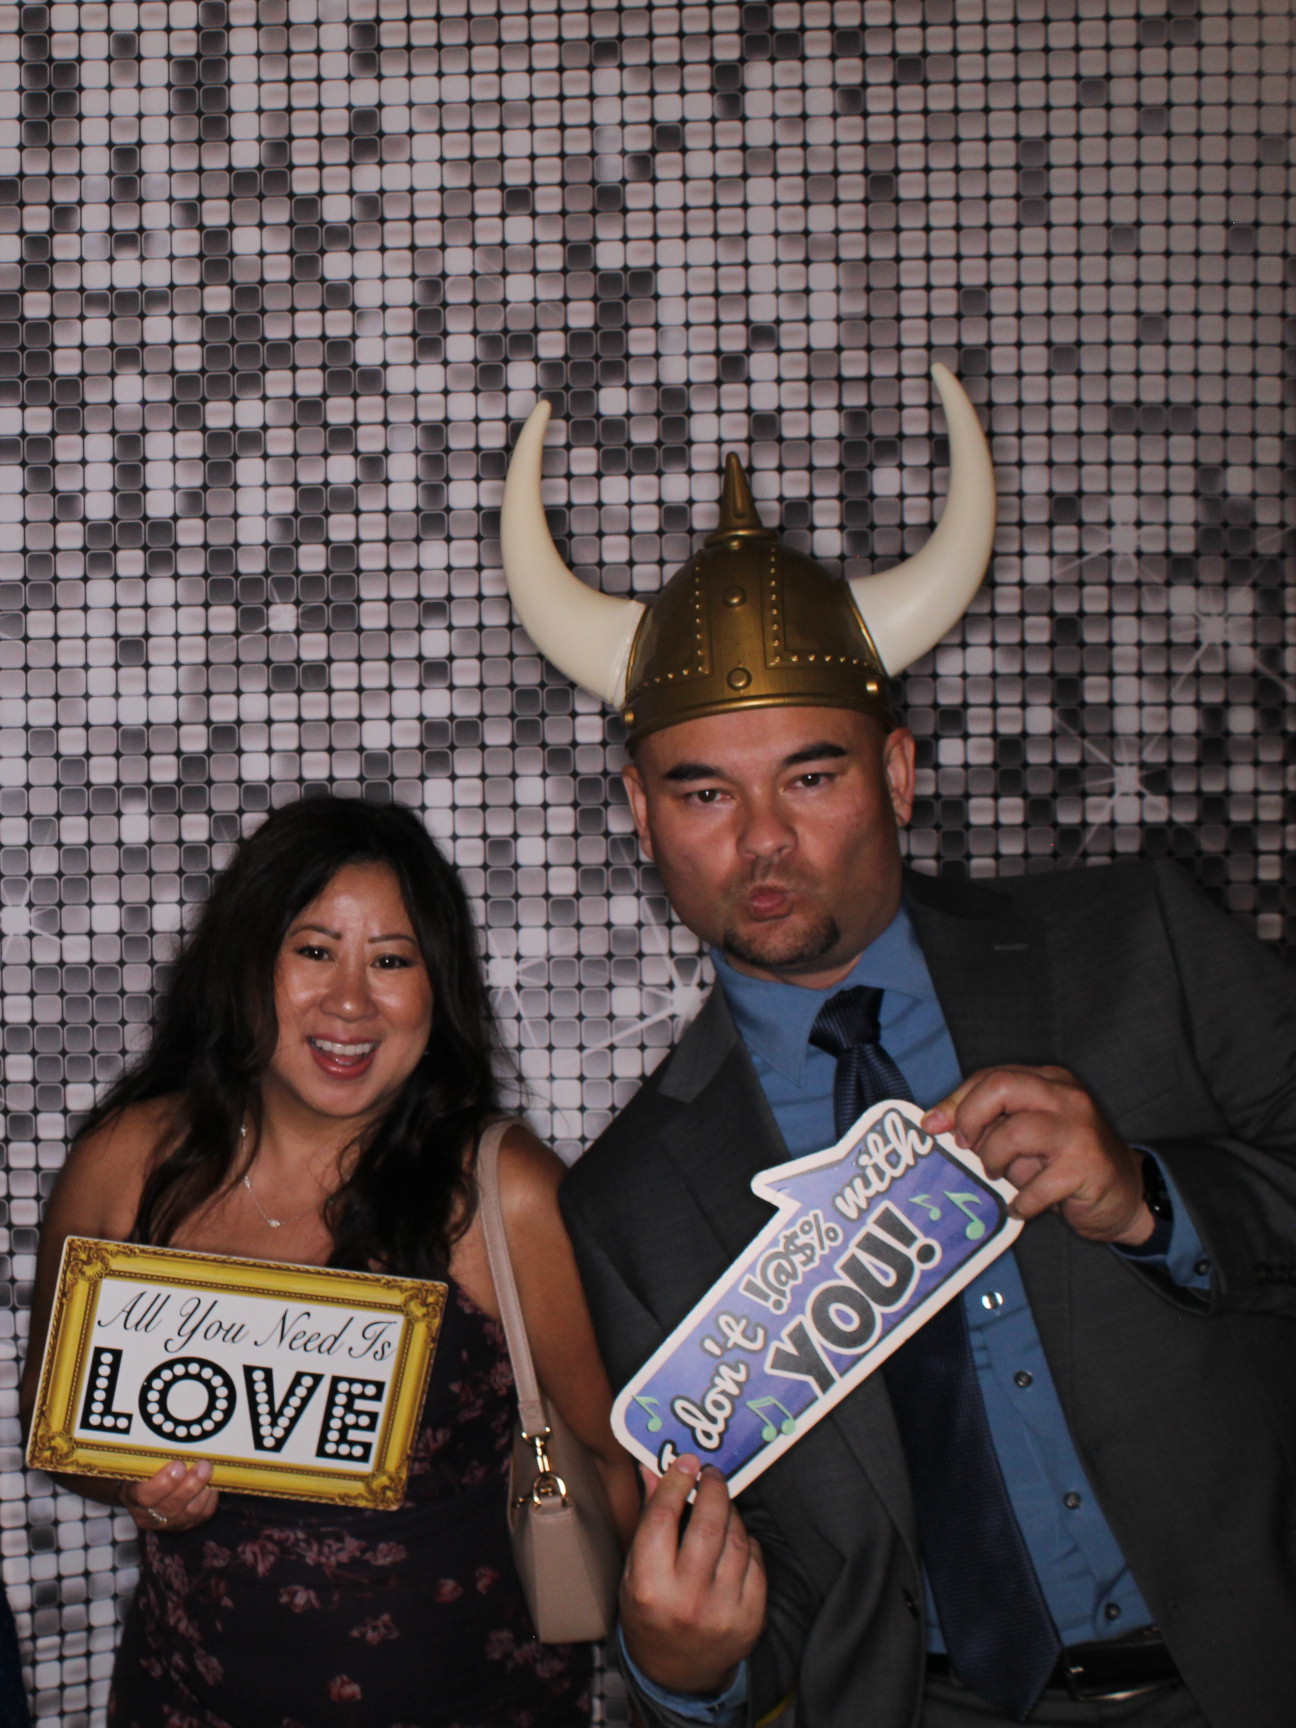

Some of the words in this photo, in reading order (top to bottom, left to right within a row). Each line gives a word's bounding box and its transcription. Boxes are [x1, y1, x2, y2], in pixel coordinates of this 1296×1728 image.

[97, 1289, 172, 1334] All
[164, 1296, 249, 1354] You
[253, 1308, 354, 1356] Need
[348, 1320, 398, 1362] Is
[671, 1311, 767, 1451] don't
[740, 1211, 842, 1313] !@$%
[833, 1109, 934, 1221] with
[766, 1202, 939, 1396] YOU!
[79, 1345, 386, 1464] LOVE
